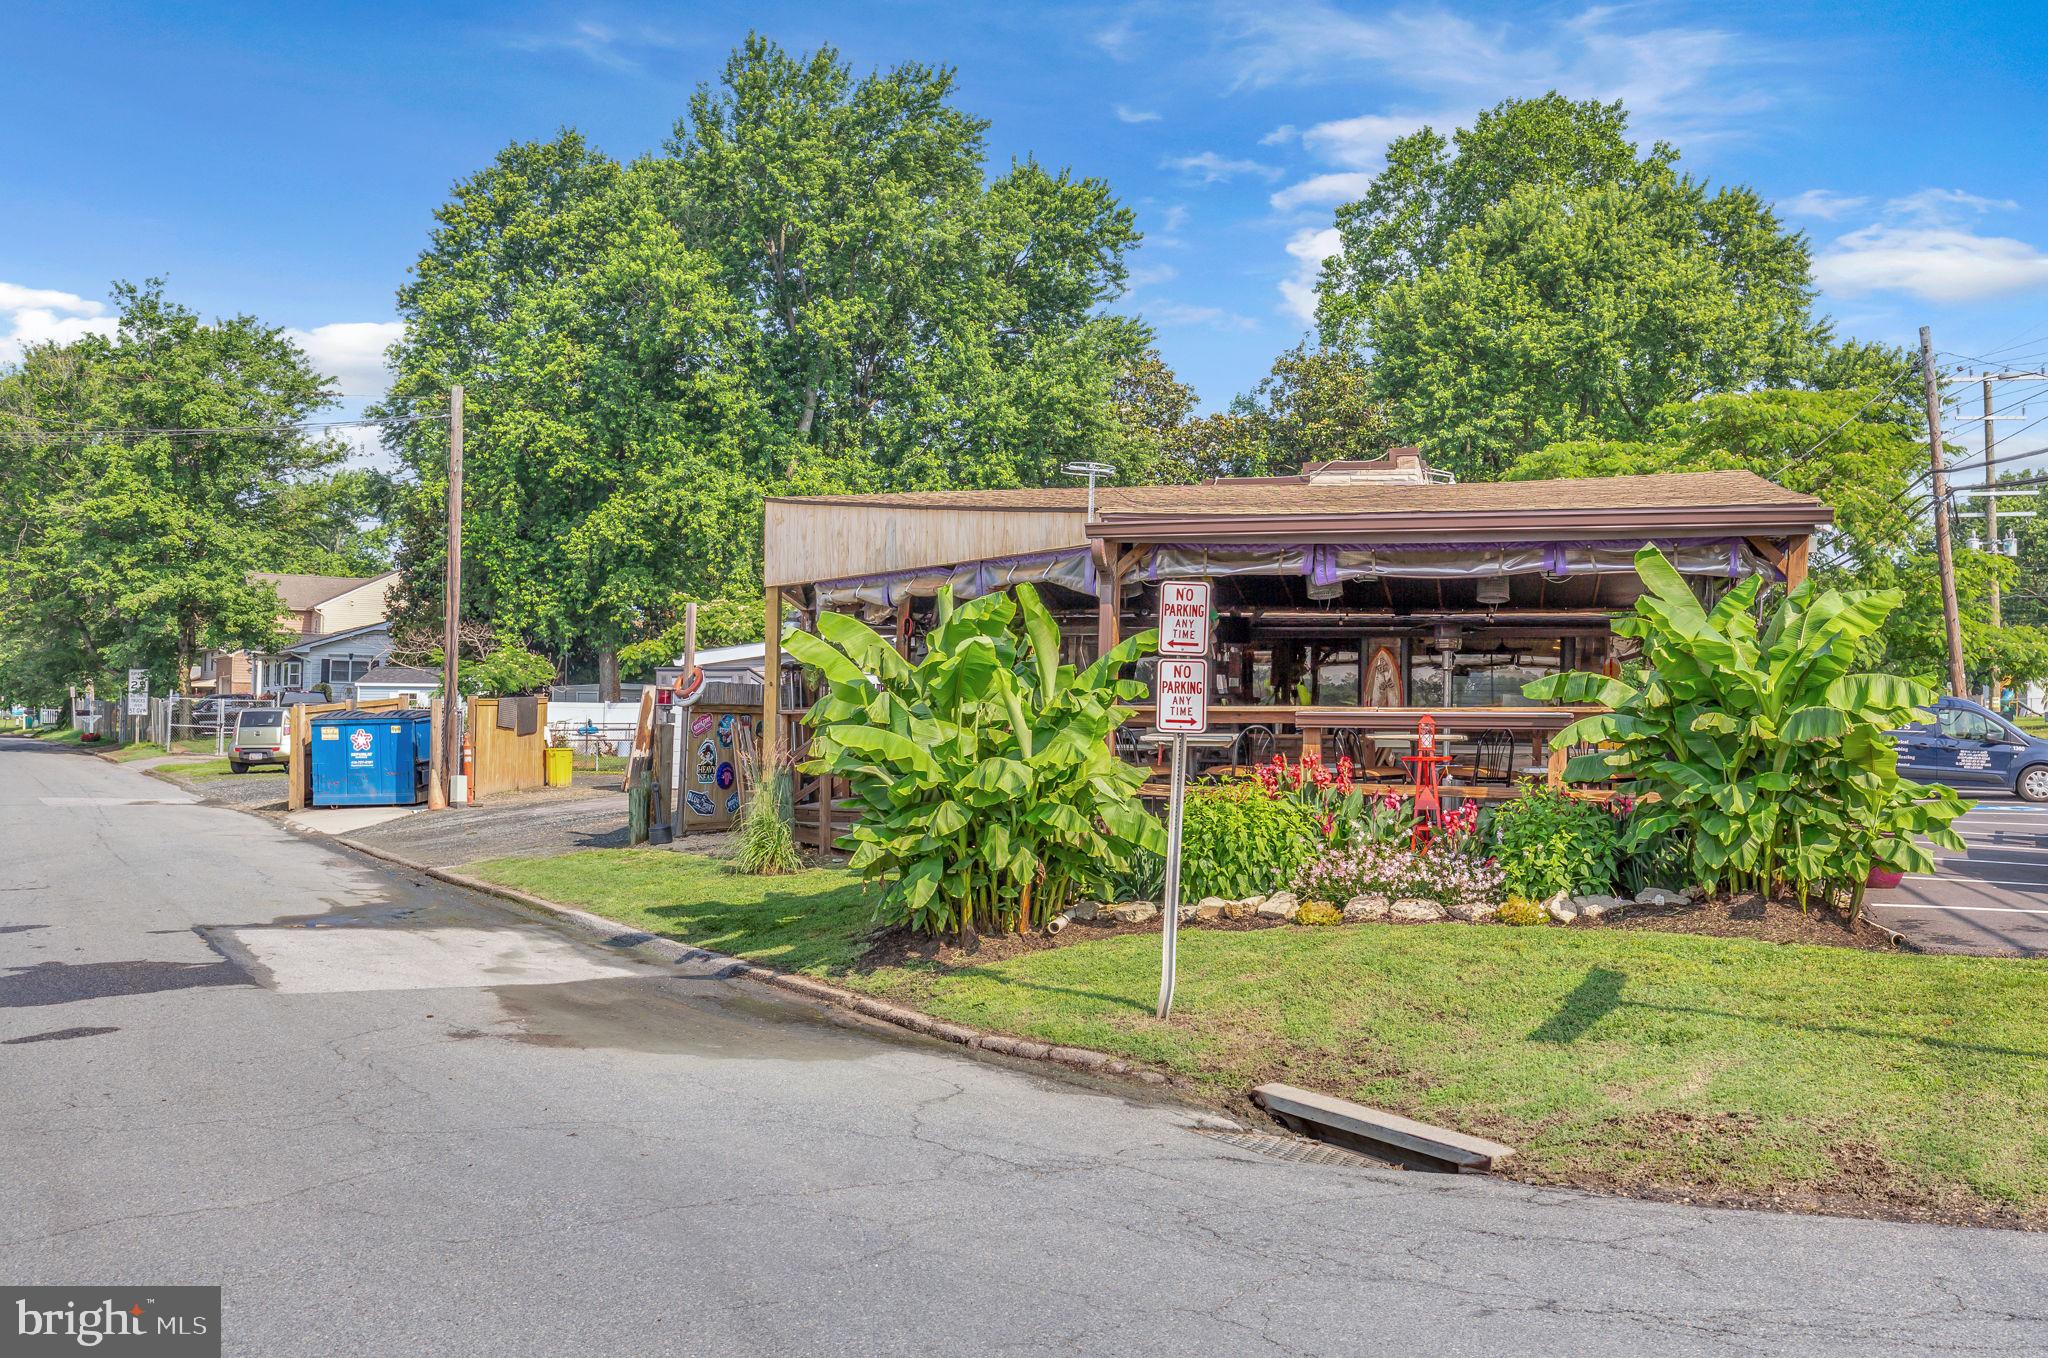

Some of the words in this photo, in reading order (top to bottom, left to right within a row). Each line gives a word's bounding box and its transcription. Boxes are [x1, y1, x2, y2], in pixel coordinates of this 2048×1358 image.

[1176, 588, 1194, 601] NO
[1164, 604, 1204, 617] PARKING
[1175, 619, 1194, 628] ANY
[1173, 630, 1195, 639] TIME
[1173, 665, 1191, 678] NO
[1161, 681, 1202, 694] PARKING
[1172, 696, 1191, 705] ANY
[1170, 707, 1193, 716] TIME
[699, 765, 715, 773] HEAVY
